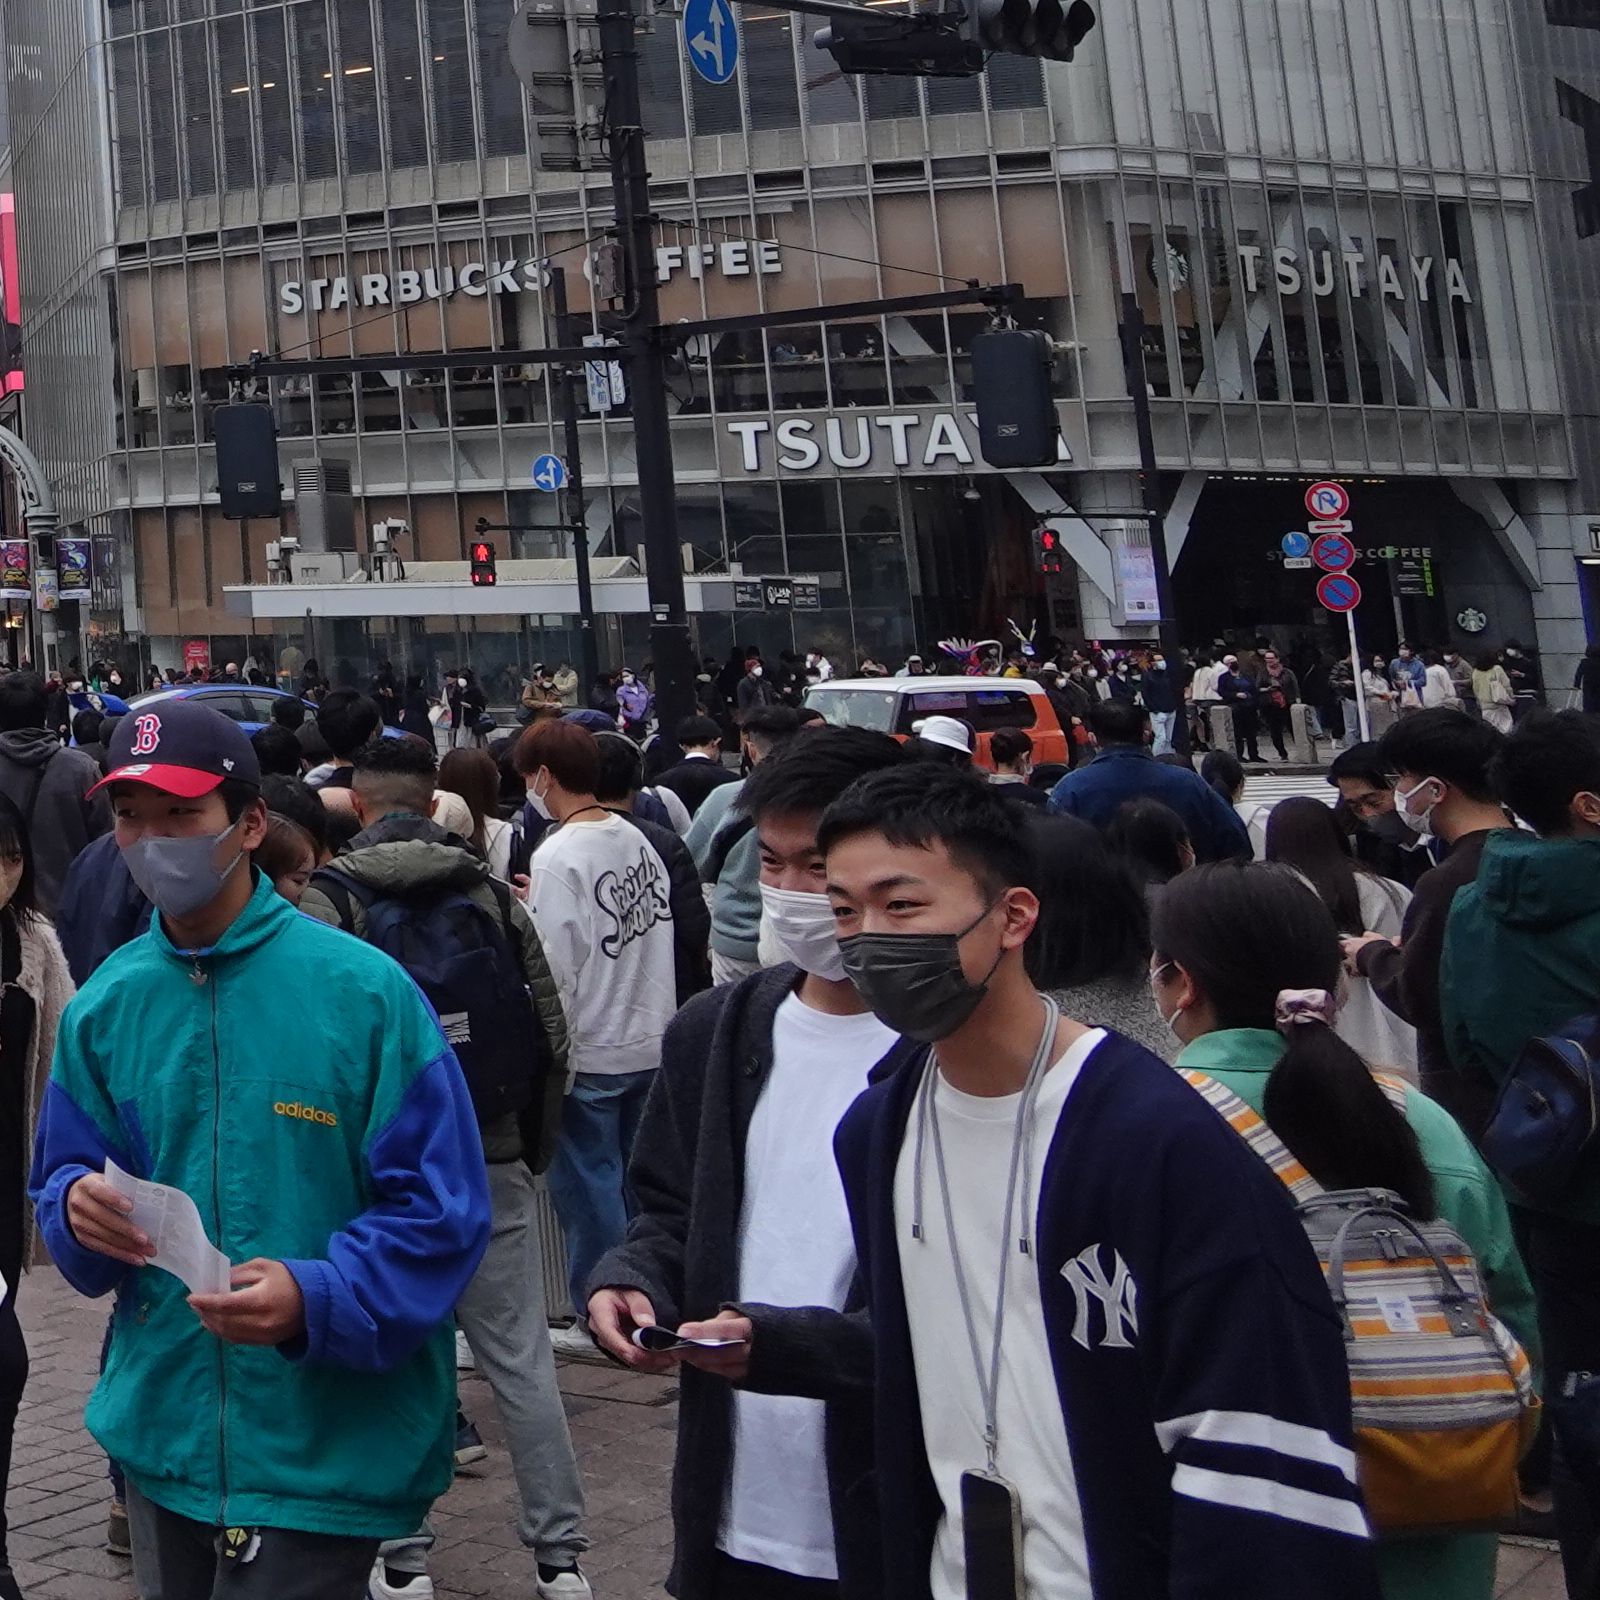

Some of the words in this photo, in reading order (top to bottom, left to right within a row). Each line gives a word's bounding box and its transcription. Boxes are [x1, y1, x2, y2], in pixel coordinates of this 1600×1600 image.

[280, 257, 552, 315] STARBUCKS
[1237, 244, 1474, 304] TSUTAYA
[130, 713, 161, 756] B
[273, 1101, 339, 1136] adidas
[1059, 1243, 1138, 1352] NY
